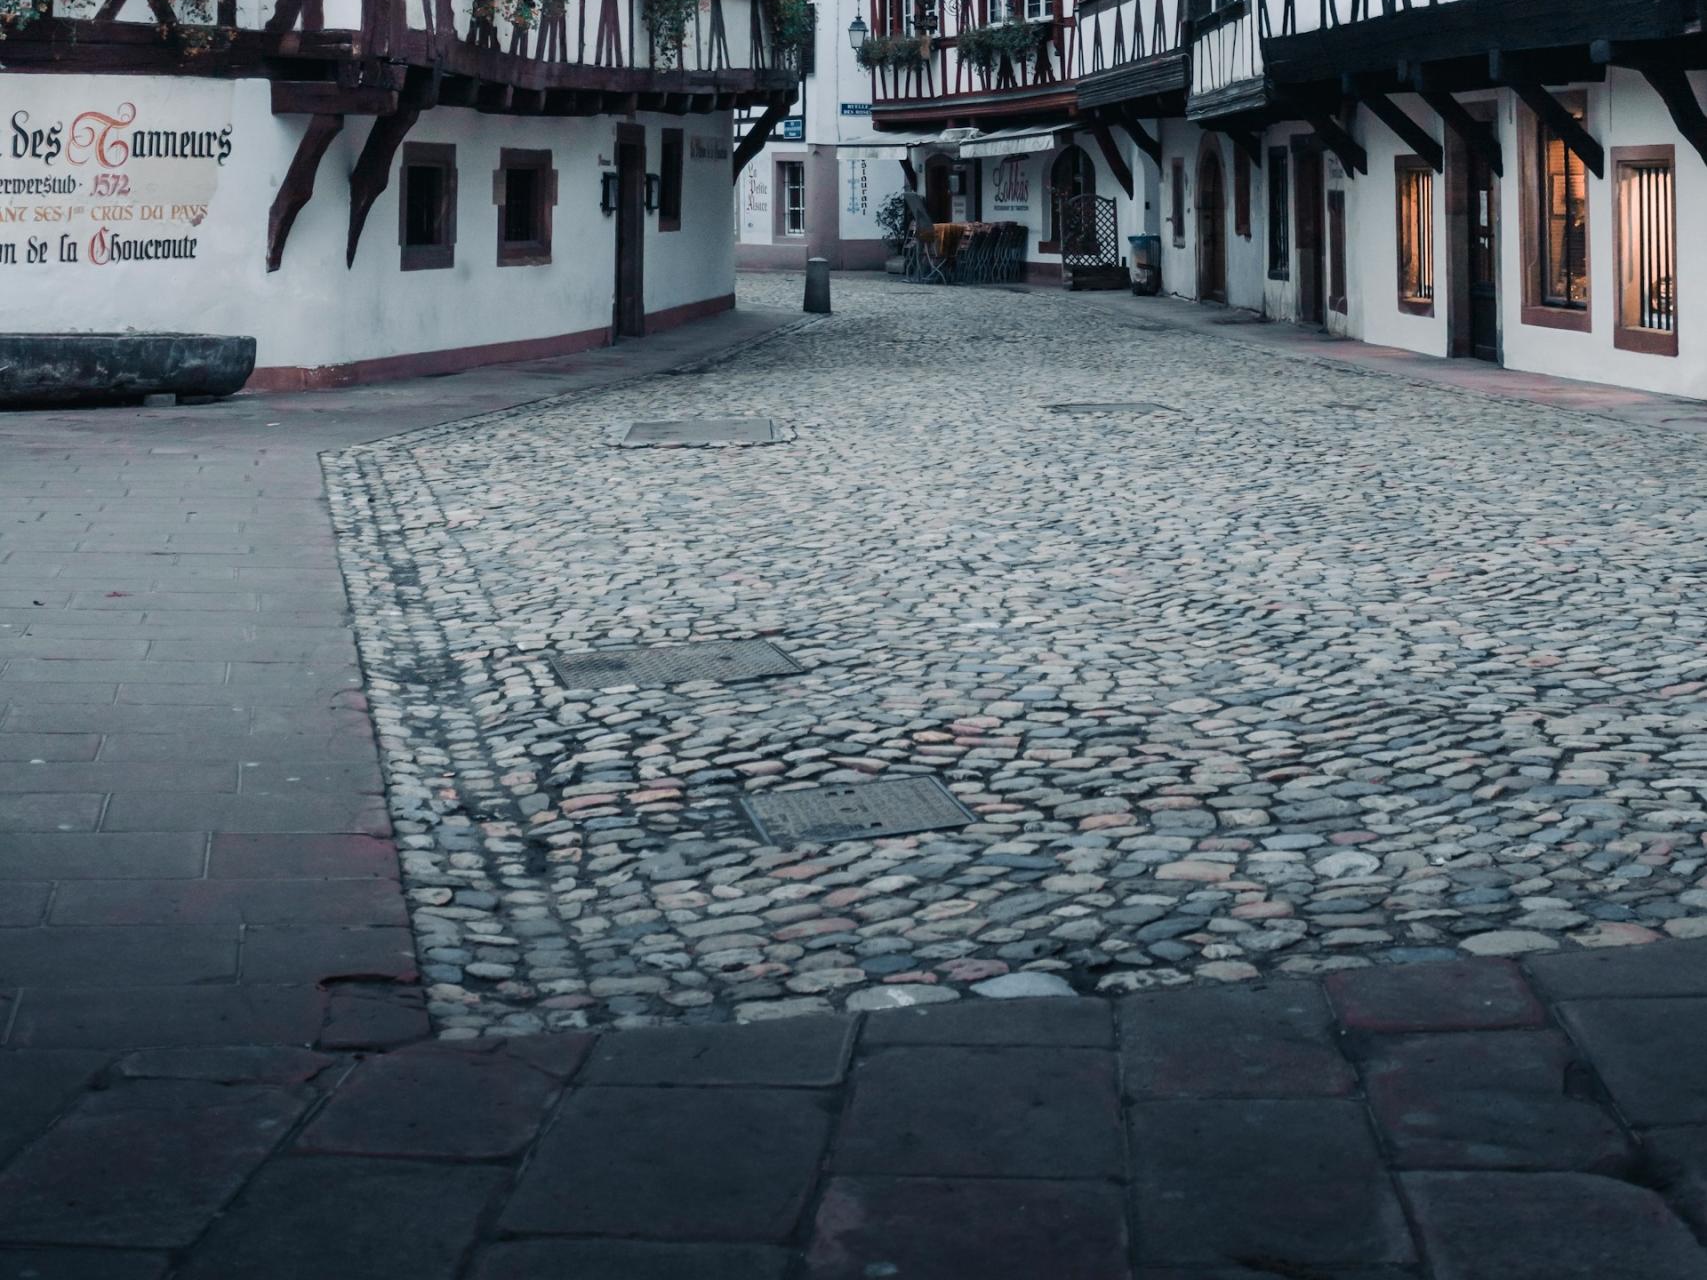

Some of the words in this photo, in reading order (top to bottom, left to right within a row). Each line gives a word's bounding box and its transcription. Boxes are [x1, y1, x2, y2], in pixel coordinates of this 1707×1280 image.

[11, 109, 63, 166] des
[65, 101, 233, 168] Tanneurs
[89, 173, 131, 197] 1572
[0, 206, 28, 222] NT
[90, 205, 133, 222] CRUS
[140, 204, 163, 221] DU
[0, 243, 17, 265] n
[26, 235, 48, 264] de
[59, 233, 78, 262] la
[88, 226, 198, 265] Choucroute
